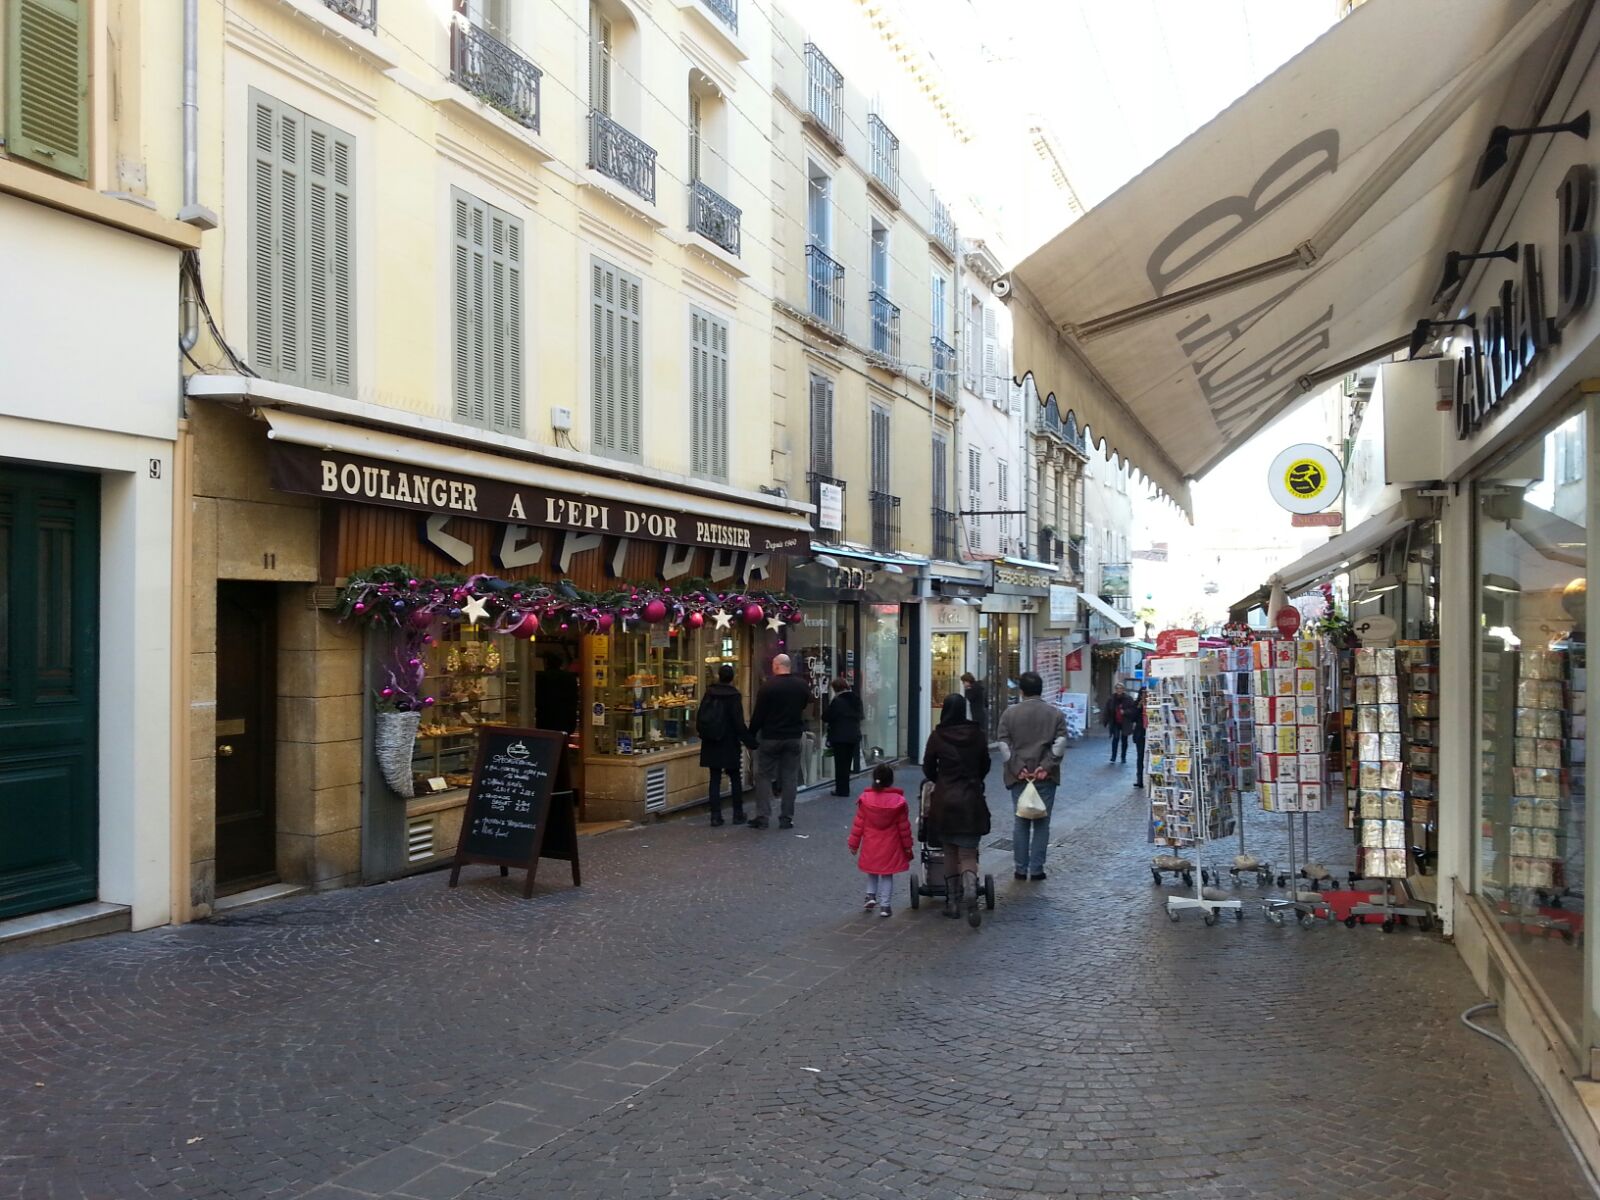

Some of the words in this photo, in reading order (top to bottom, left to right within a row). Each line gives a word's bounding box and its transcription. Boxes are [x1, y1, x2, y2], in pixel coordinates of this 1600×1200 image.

[149, 459, 161, 479] 9
[320, 459, 478, 512] BOULANGER
[507, 492, 527, 520] A
[545, 497, 610, 531] L'EPI
[624, 510, 678, 538] D'OR
[696, 521, 751, 548] PATISSIER
[263, 553, 276, 570] 11
